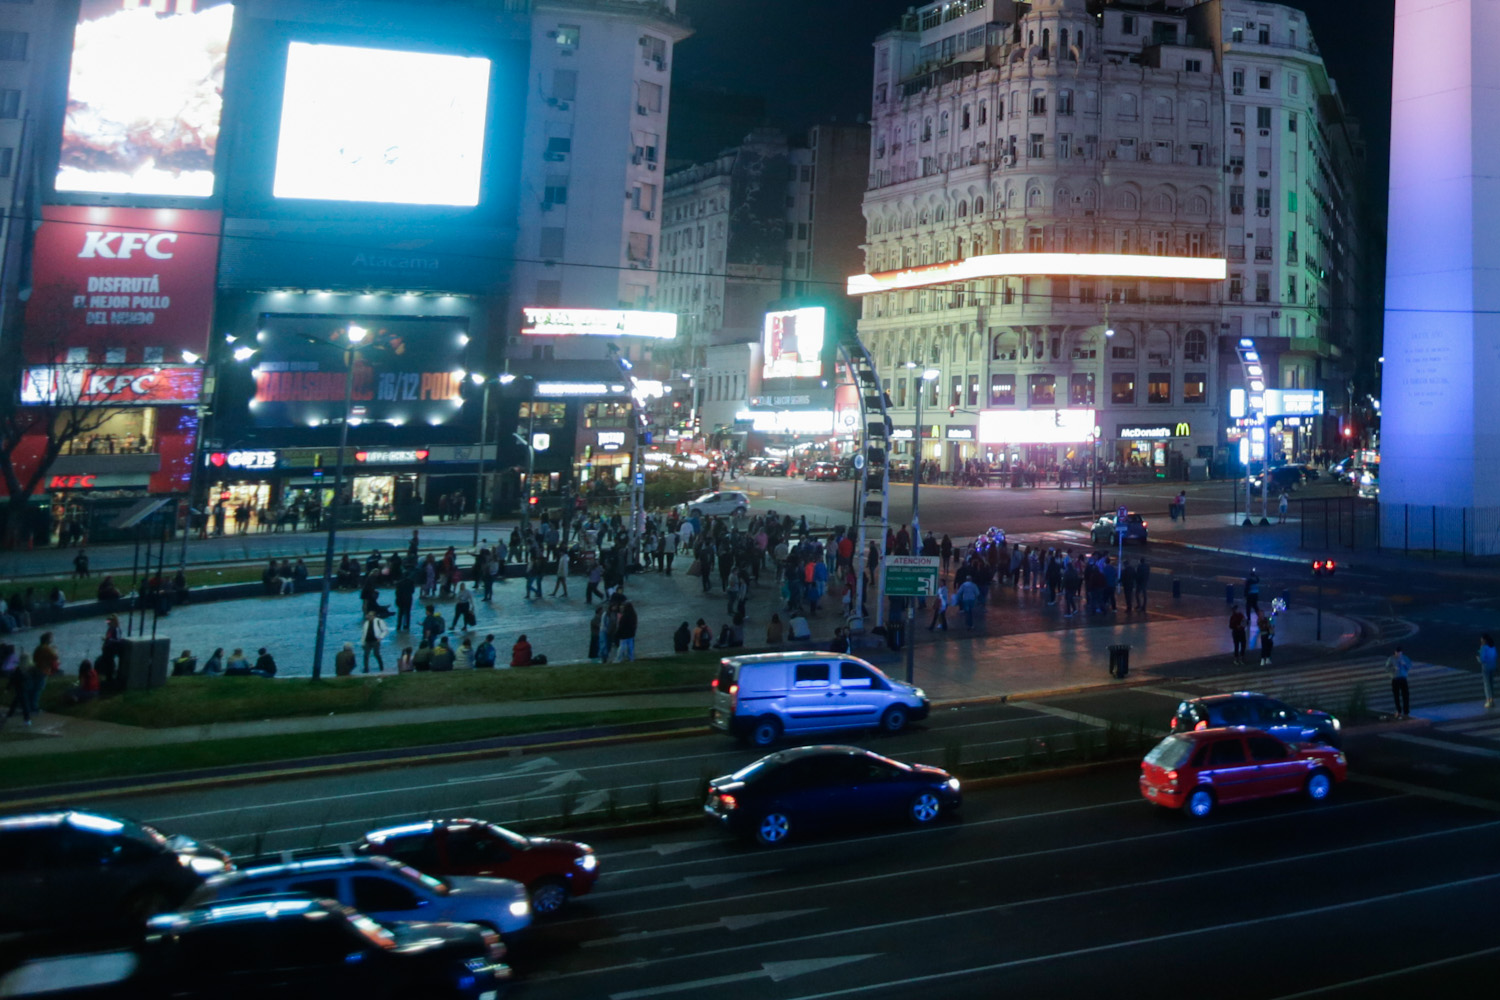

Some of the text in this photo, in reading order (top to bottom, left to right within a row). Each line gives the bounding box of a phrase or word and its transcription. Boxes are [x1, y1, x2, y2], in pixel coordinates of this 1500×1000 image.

[77, 231, 178, 260] KFC
[352, 253, 439, 269] Atacama
[87, 274, 160, 293] DISFRUTÁ
[89, 295, 131, 309] MEJOR
[132, 296, 170, 309] POLLO
[85, 375, 156, 395] KFC
[378, 372, 419, 402] 16/12
[1120, 427, 1171, 438] McDonald's
[227, 451, 277, 466] GIFTS
[50, 474, 97, 488] KFC
[893, 557, 932, 565] ATENCION
